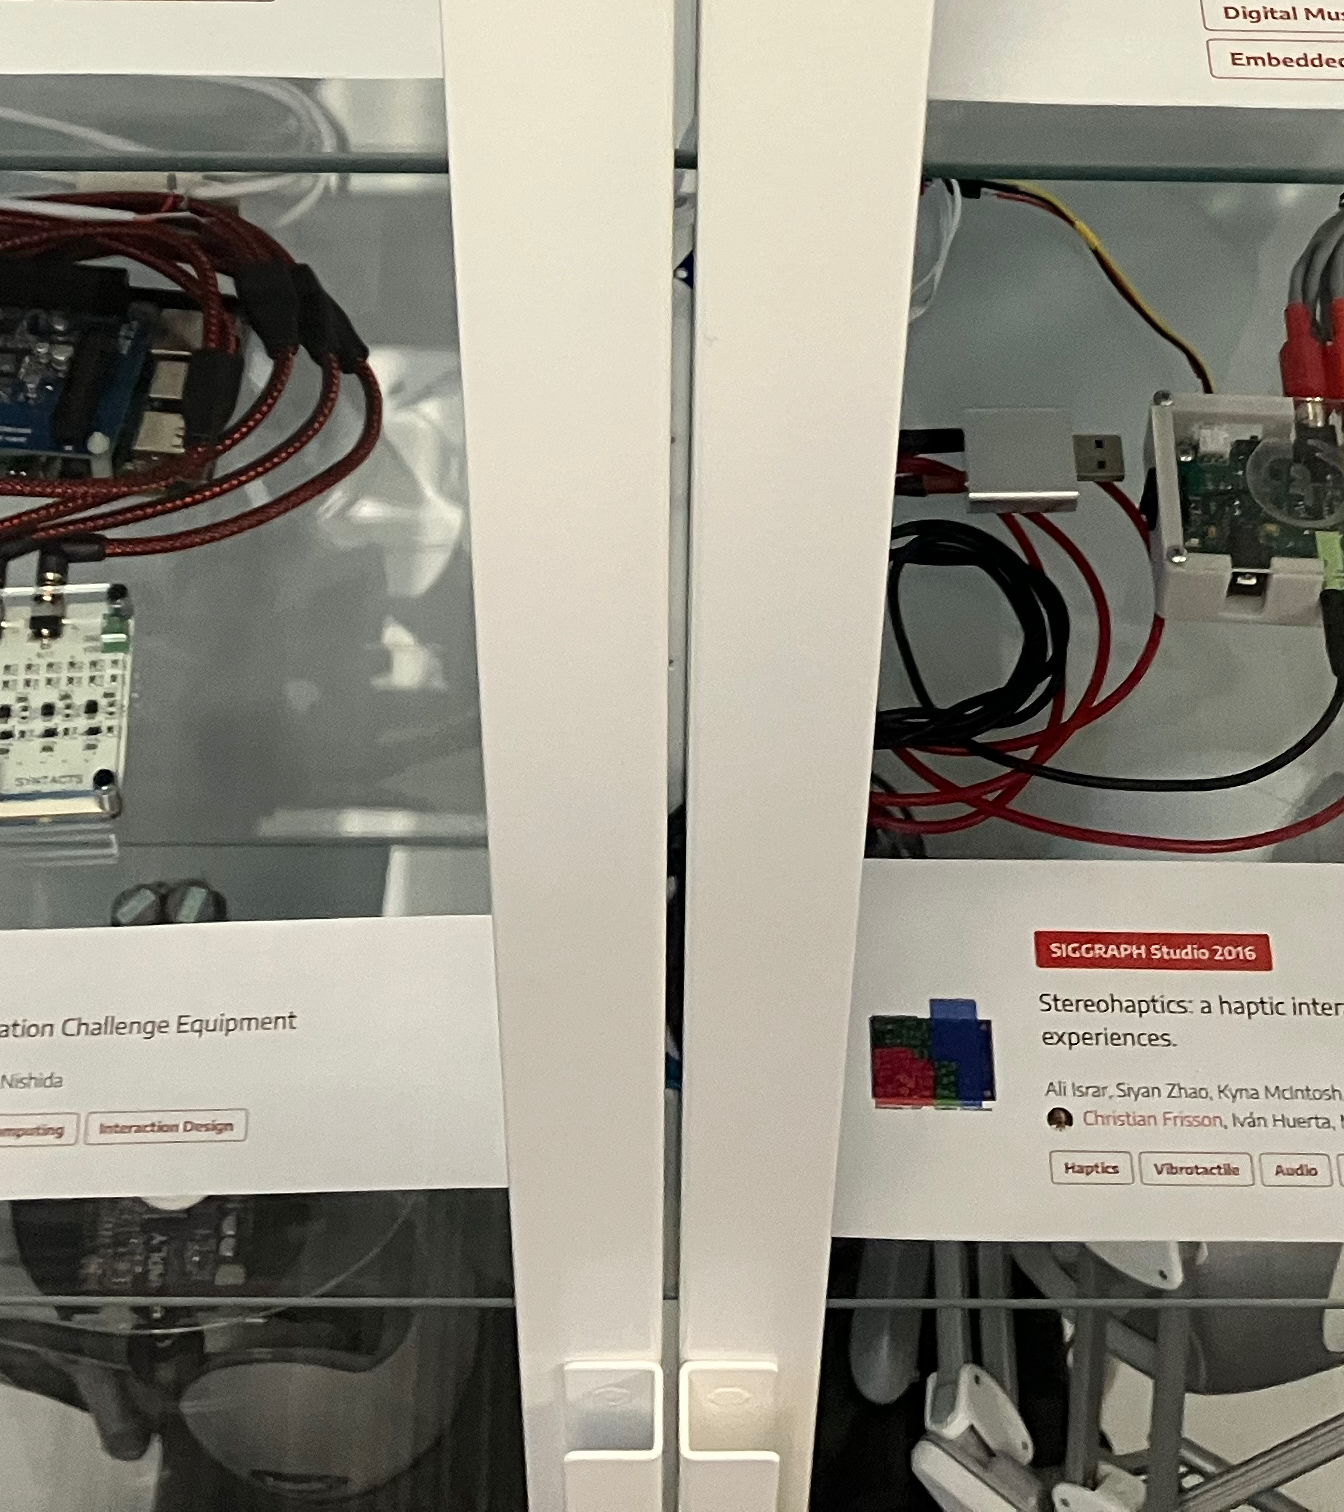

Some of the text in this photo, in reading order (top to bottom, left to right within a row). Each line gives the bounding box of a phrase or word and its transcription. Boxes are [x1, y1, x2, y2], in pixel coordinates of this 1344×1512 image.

[1223, 5, 1298, 23] Digital
[1050, 943, 1256, 961] SIGGRAPH Studio 2016
[1039, 994, 1194, 1017] Stereohaptics:
[1200, 999, 1212, 1014] a
[1219, 995, 1286, 1018] haptic
[62, 1015, 169, 1041] Challenge
[176, 1012, 297, 1037] Equipment
[1042, 1029, 1178, 1050] experiences.
[1, 1073, 63, 1090] Nishida
[99, 1119, 233, 1136] Interaction Design
[1083, 1111, 1157, 1128] Christian
[1162, 1111, 1227, 1130] Frisson,
[1272, 1113, 1336, 1132] Huerta,
[1064, 1161, 1119, 1177] Haptics
[1154, 1162, 1240, 1176] Vibrotactile
[1275, 1163, 1318, 1177] Audio
